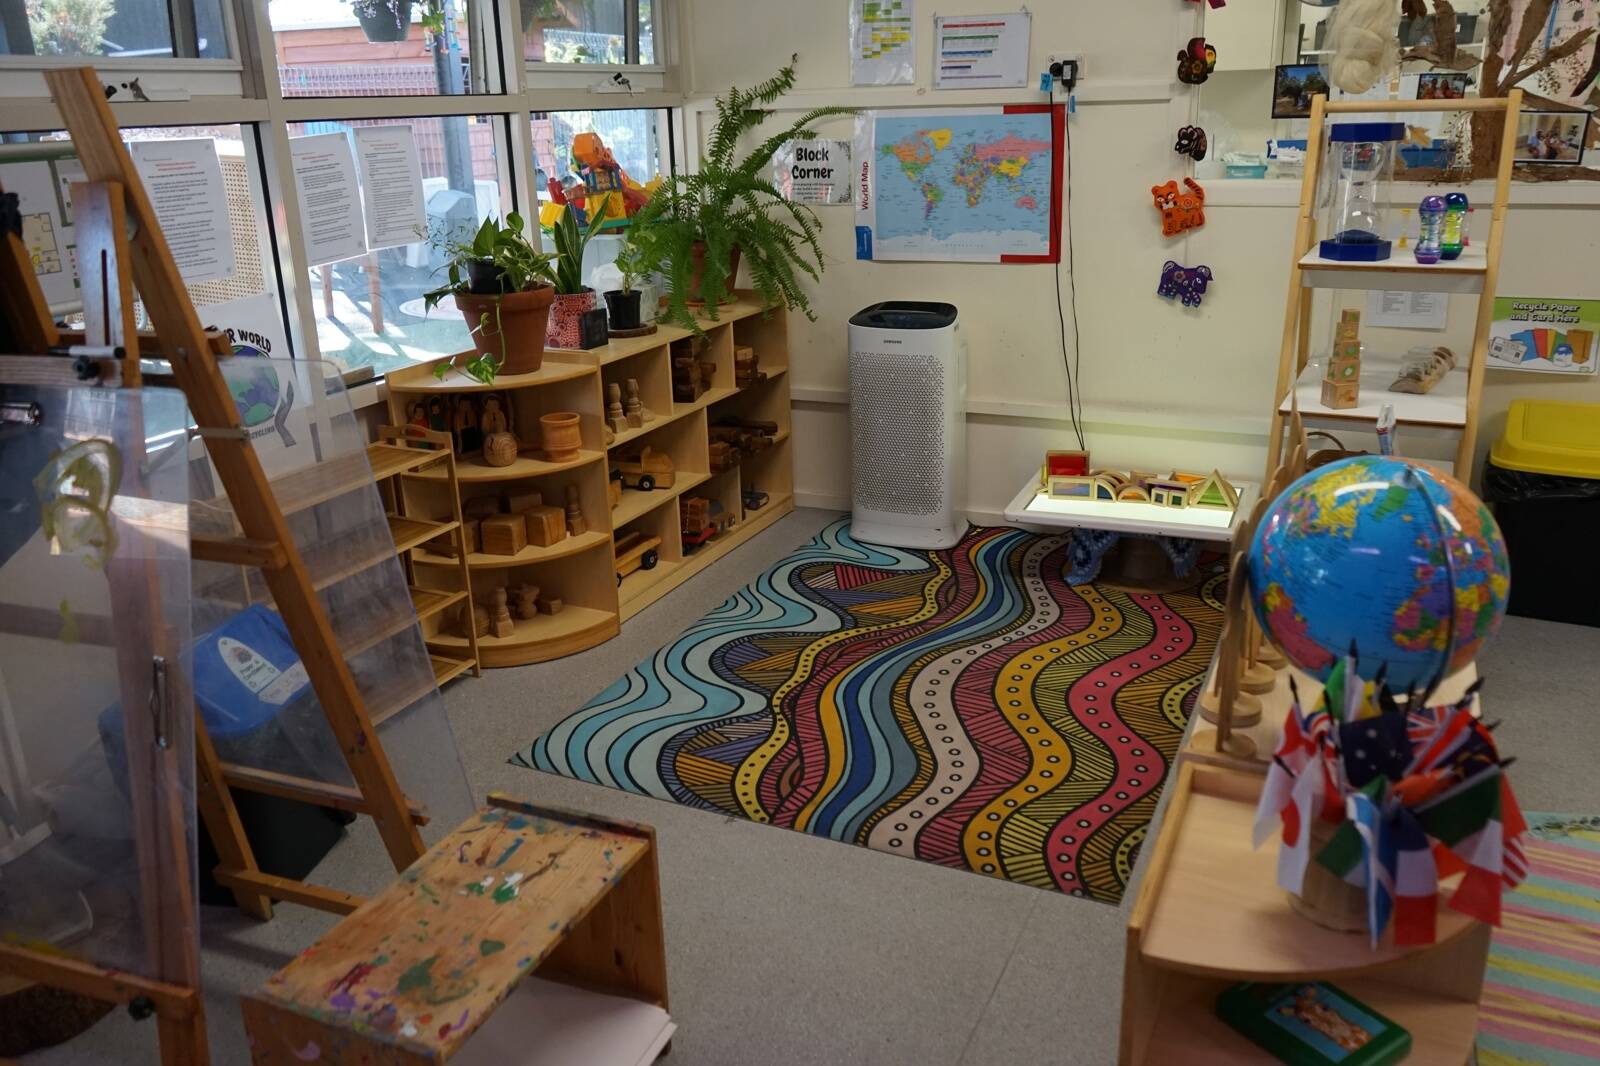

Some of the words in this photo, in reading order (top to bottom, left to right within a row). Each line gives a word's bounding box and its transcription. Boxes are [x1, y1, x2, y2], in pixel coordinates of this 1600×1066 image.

[795, 147, 829, 162] Block
[791, 165, 834, 179] Corner
[861, 161, 869, 182] Map
[861, 184, 869, 210] World
[1512, 302, 1549, 312] Recycle
[1551, 303, 1580, 314] Paper
[1510, 313, 1529, 321] and
[1532, 313, 1555, 322] Card
[1555, 314, 1580, 323] Here
[237, 328, 272, 353] WORLD
[251, 425, 275, 440] CYCLING
